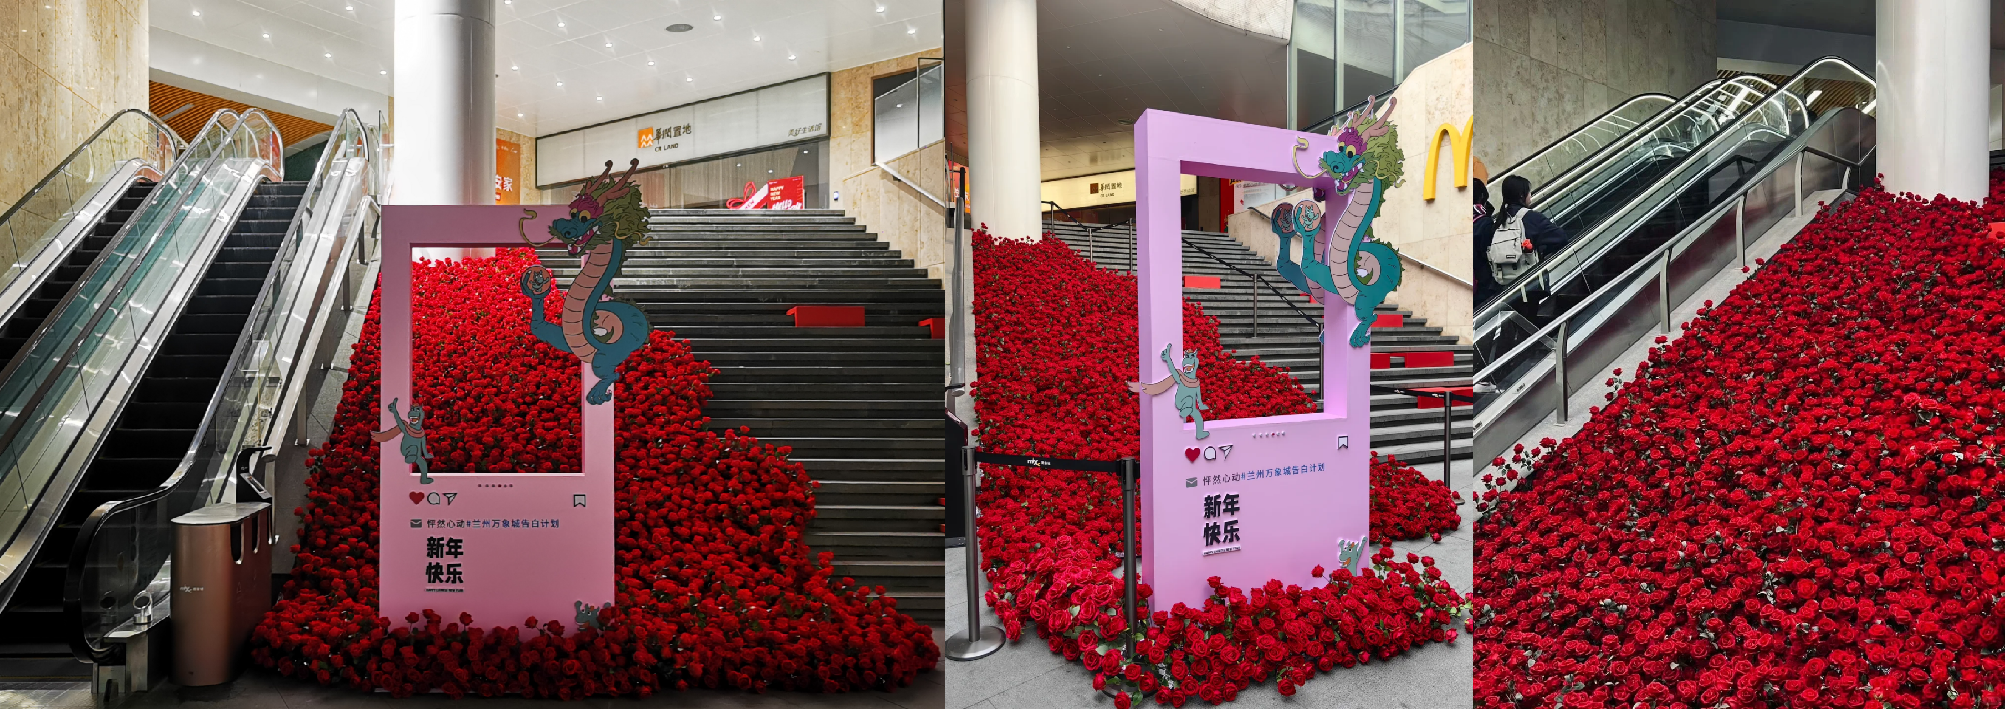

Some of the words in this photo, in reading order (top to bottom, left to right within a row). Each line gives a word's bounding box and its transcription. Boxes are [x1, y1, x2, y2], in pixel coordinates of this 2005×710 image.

[664, 143, 679, 151] LAND
[1203, 463, 1325, 486] 怦然心动#兰州万象城告白计划
[1203, 493, 1240, 519] 新年
[427, 519, 560, 528] 怦然心动#兰州万象城告白计划
[1203, 520, 1240, 547] 快乐
[426, 536, 464, 558] 新年
[425, 562, 464, 584] 快乐
